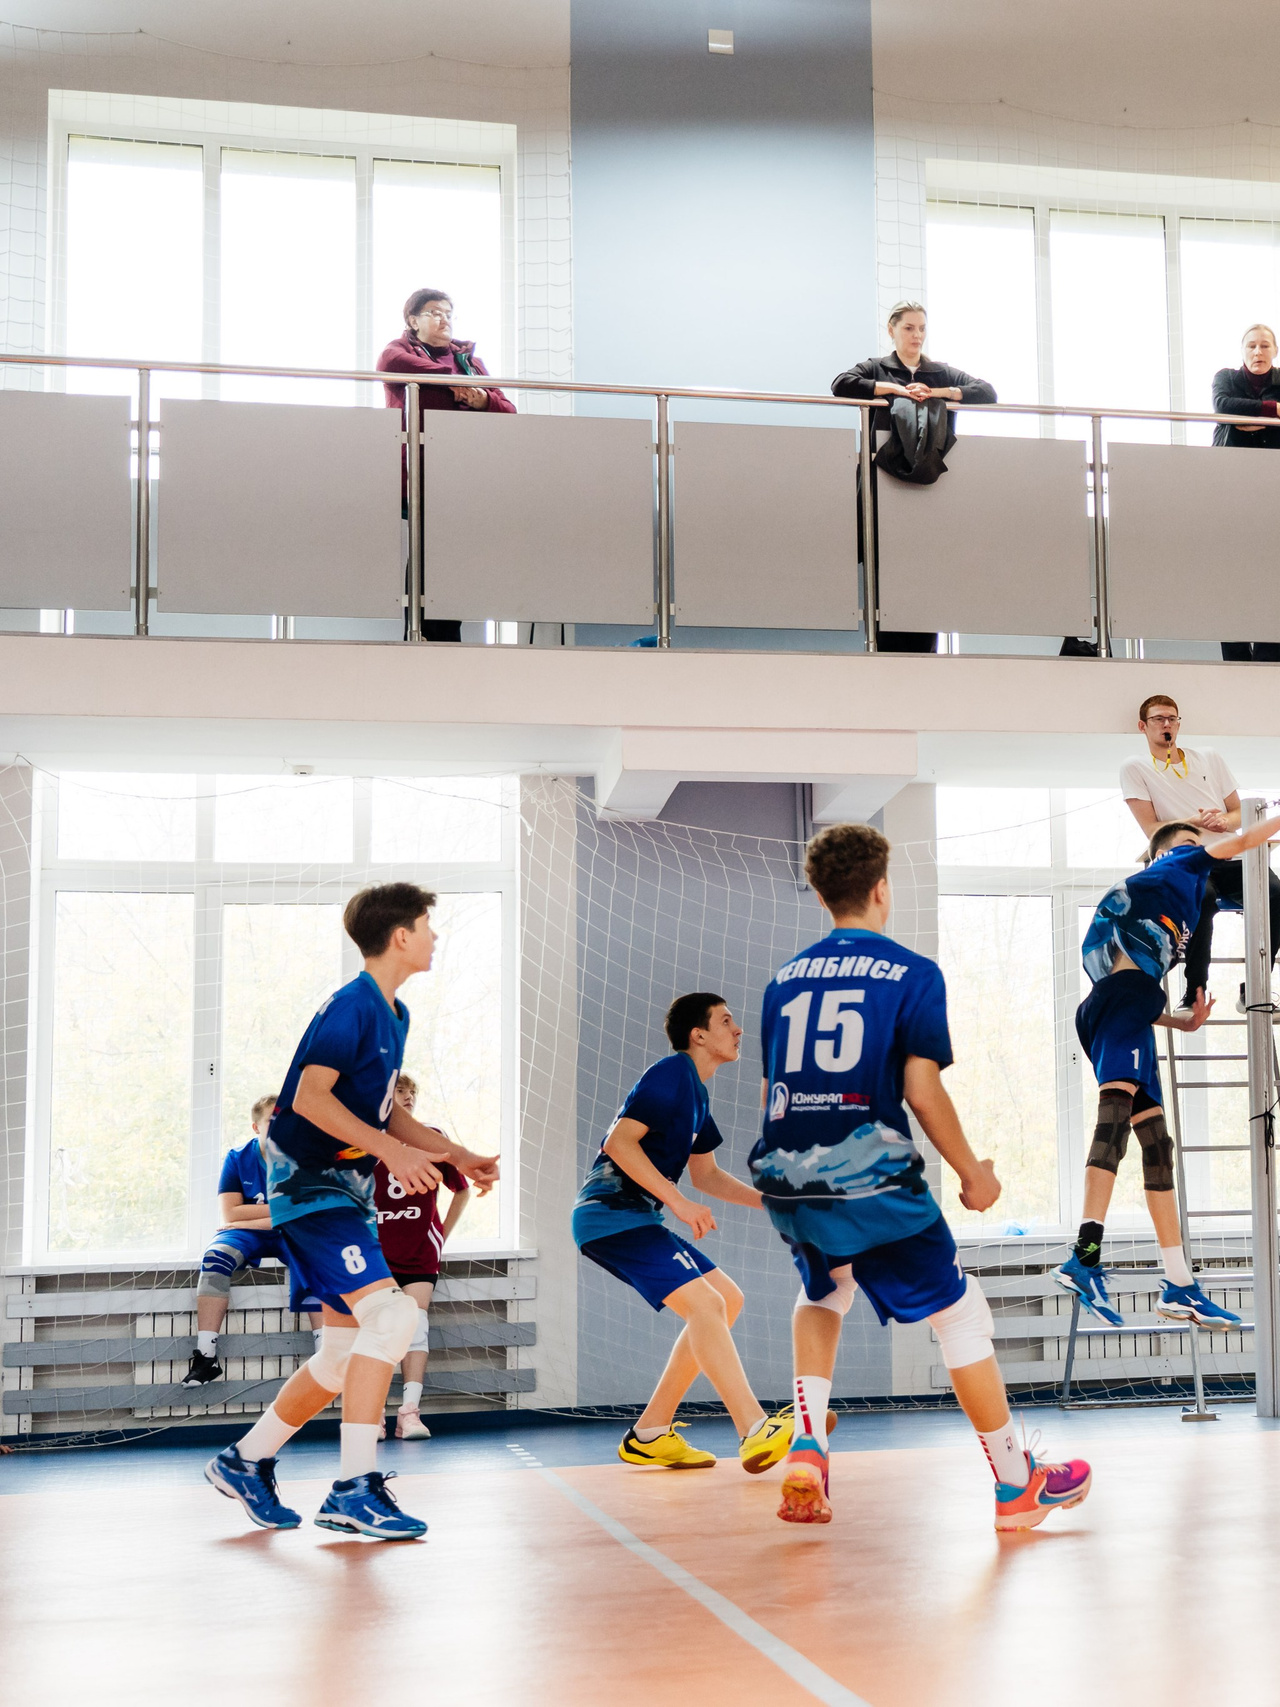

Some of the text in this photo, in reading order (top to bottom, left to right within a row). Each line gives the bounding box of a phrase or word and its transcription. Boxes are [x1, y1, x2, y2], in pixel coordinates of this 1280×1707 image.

[776, 955, 909, 985] ЧЕЛЯБИНСК
[780, 989, 866, 1074] 15
[1131, 1048, 1140, 1070] 1
[387, 1171, 407, 1199] 8
[341, 1244, 367, 1275] 8
